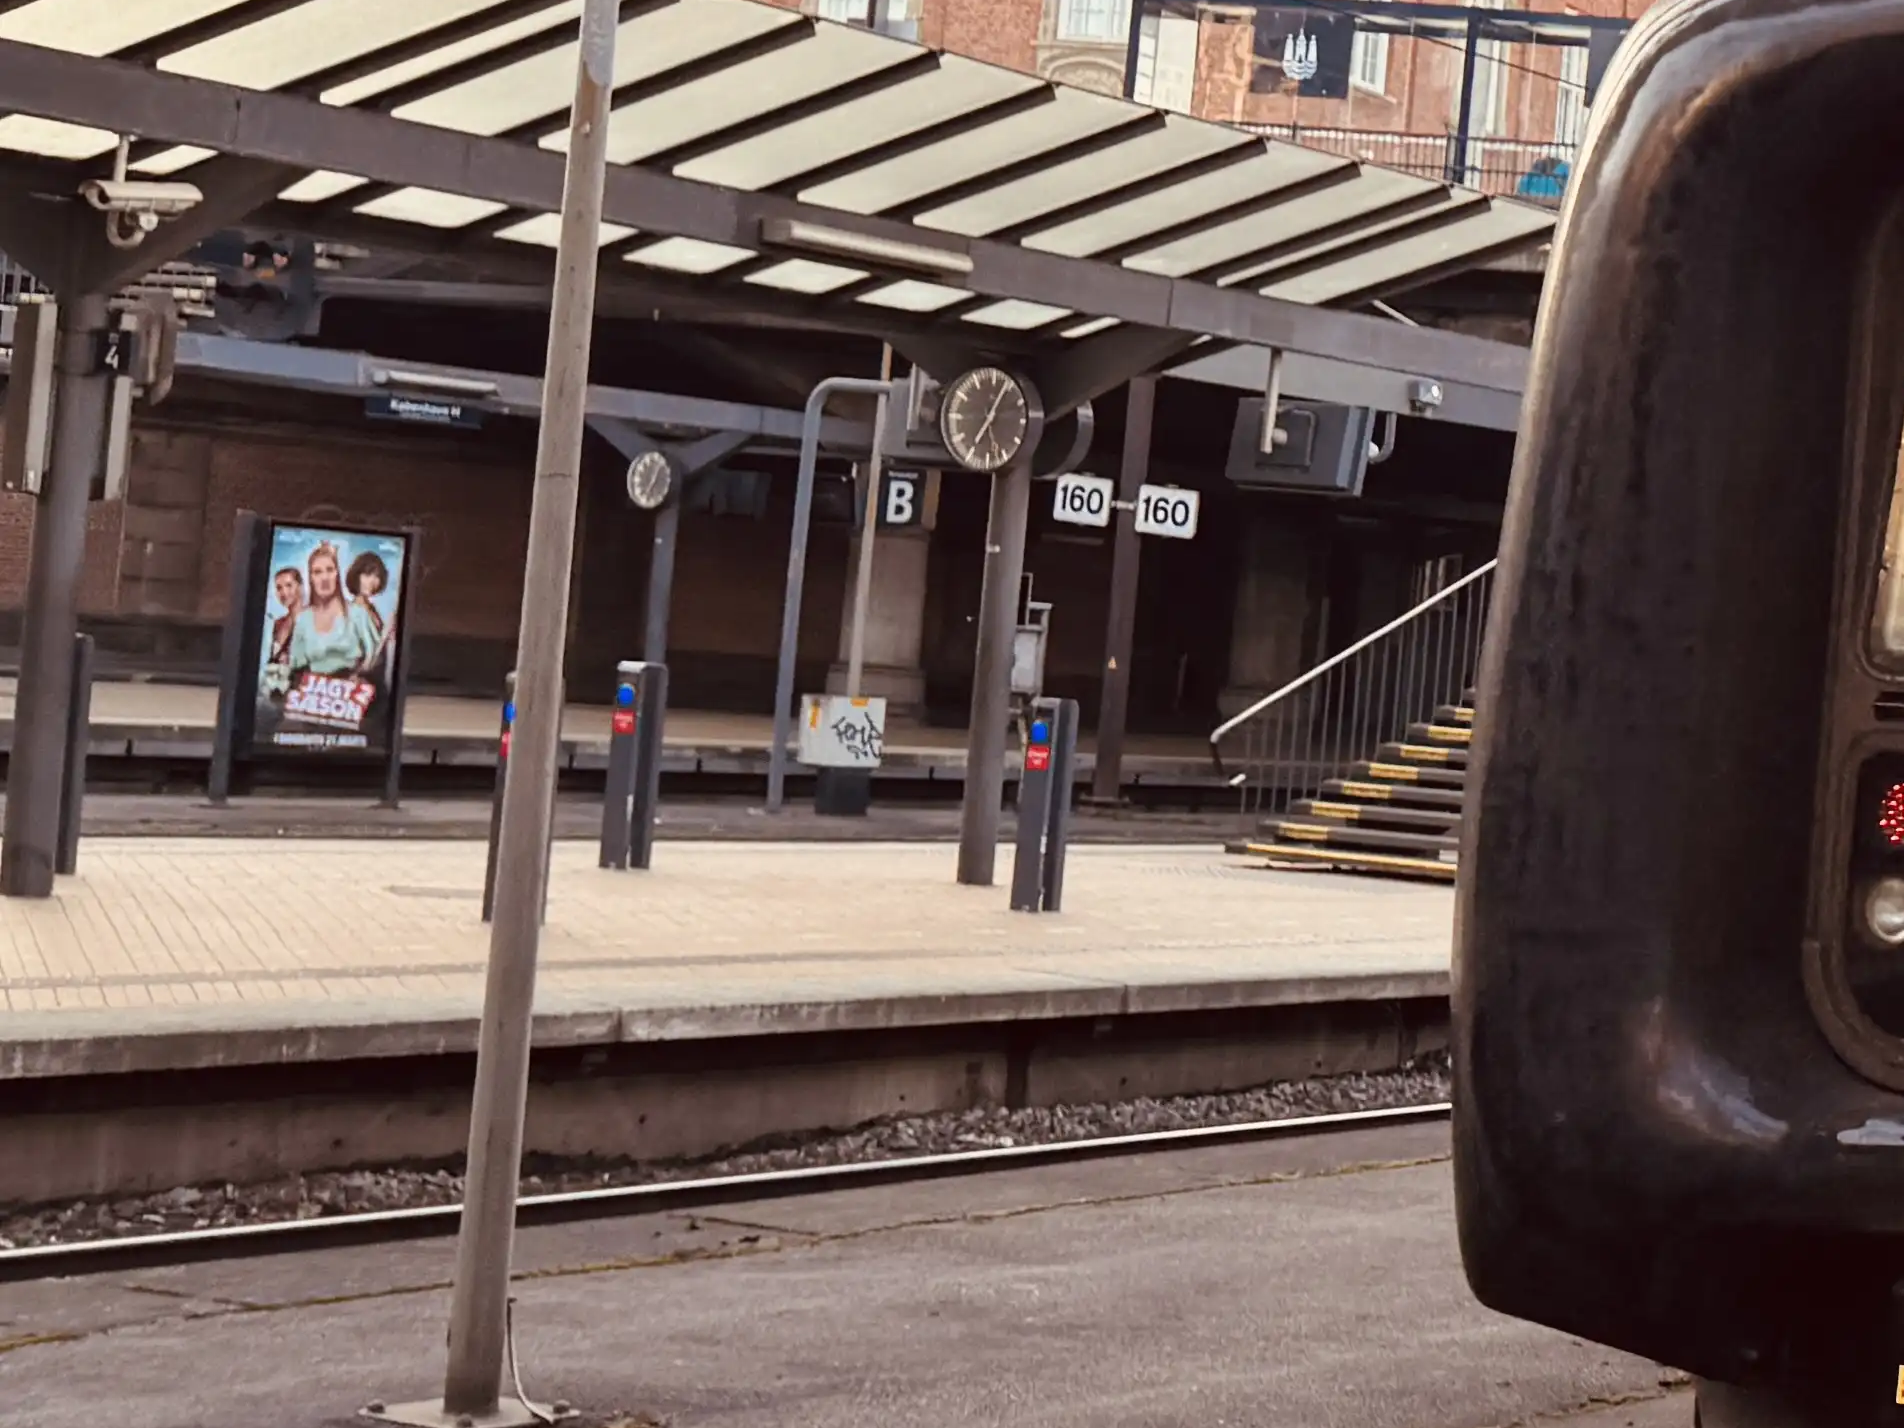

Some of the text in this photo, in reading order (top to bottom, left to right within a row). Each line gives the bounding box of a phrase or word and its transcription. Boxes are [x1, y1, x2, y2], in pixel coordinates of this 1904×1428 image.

[105, 345, 119, 370] 4
[886, 480, 914, 523] B
[1060, 483, 1104, 515] 160
[1143, 495, 1190, 527] 160
